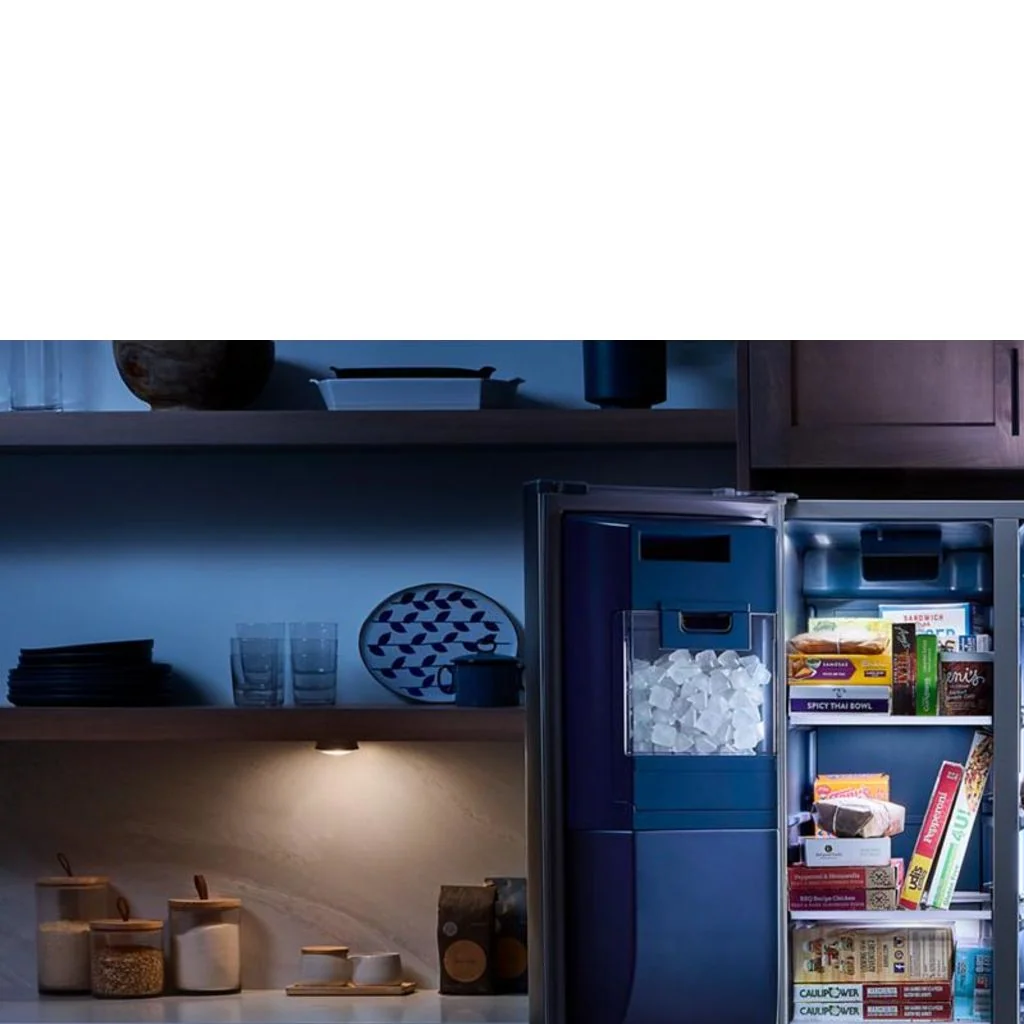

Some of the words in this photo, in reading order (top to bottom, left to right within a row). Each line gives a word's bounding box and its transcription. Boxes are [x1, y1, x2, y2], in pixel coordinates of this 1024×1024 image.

[946, 667, 986, 686] eni's
[806, 702, 829, 710] SPICY
[830, 702, 848, 710] THAI
[850, 702, 873, 710] BOWL
[923, 791, 948, 844] Pepperoni
